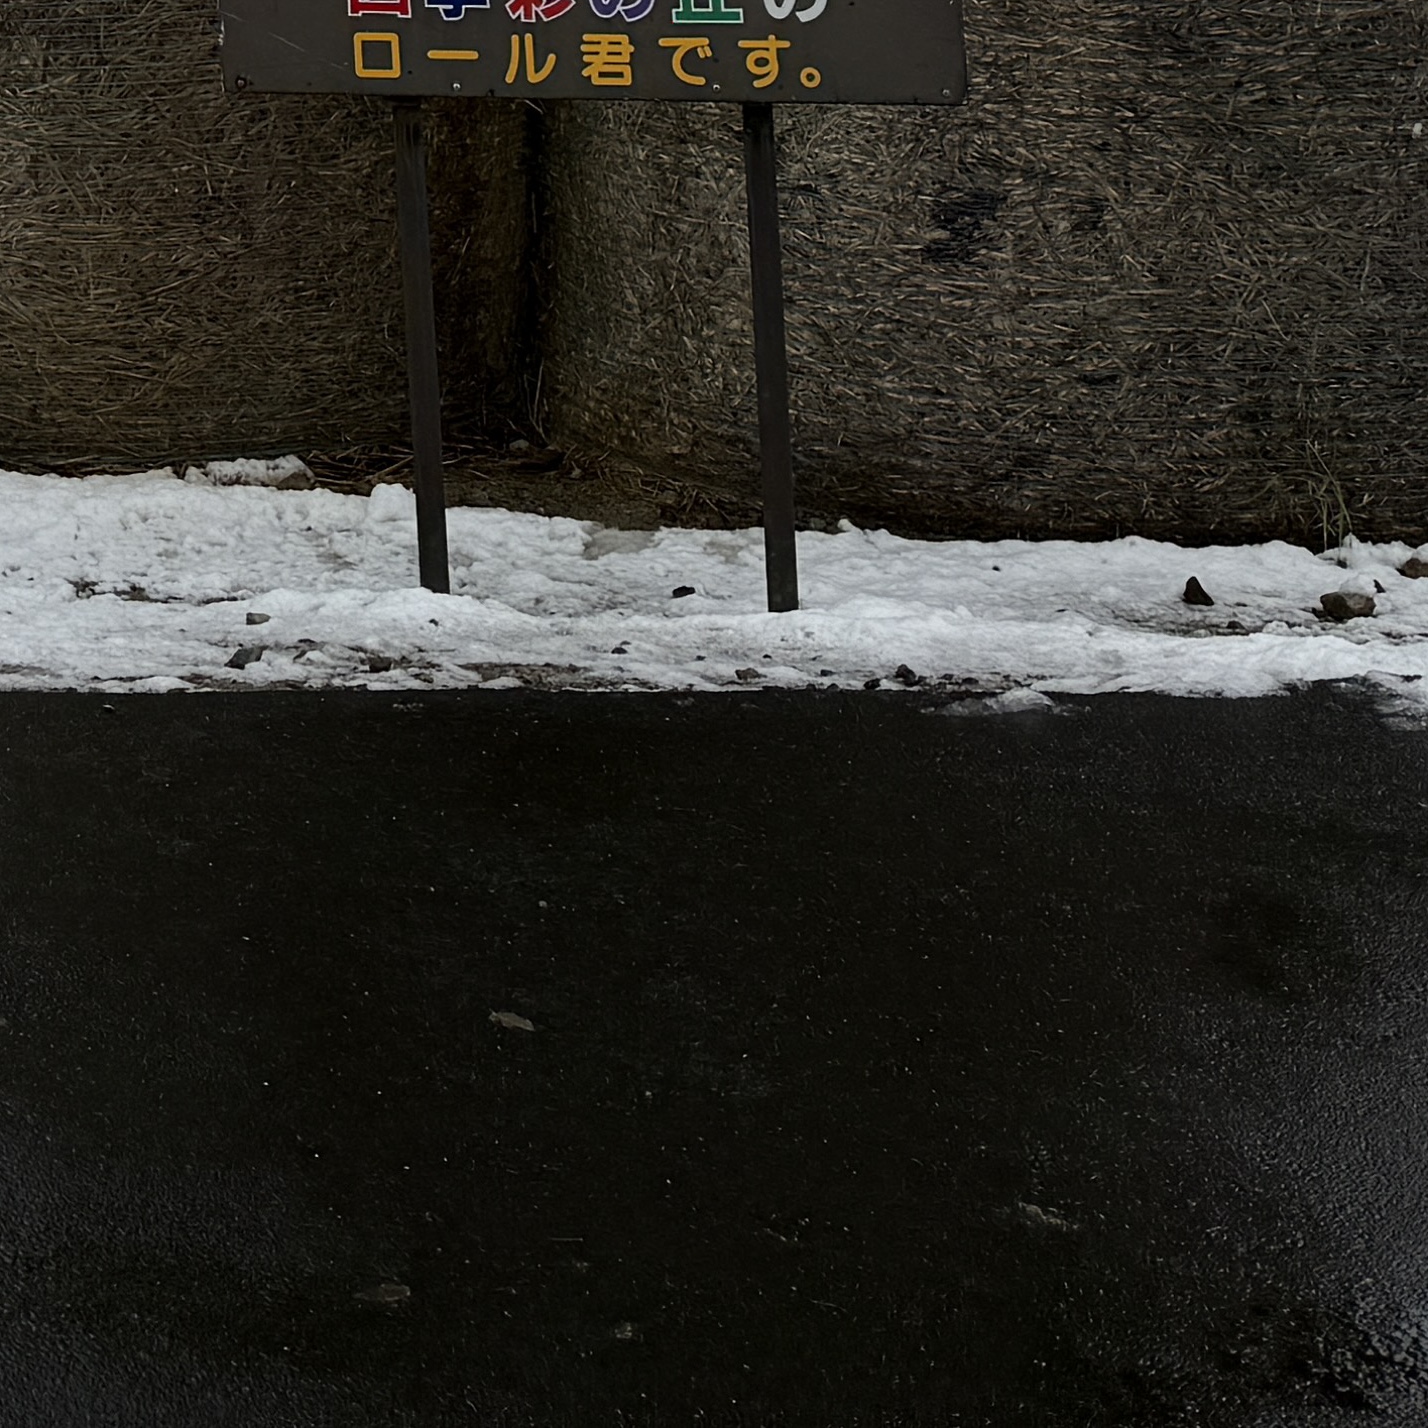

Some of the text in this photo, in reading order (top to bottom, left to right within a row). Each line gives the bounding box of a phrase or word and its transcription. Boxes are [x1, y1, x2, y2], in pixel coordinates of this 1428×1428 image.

[353, 31, 822, 88] ロール君です。
